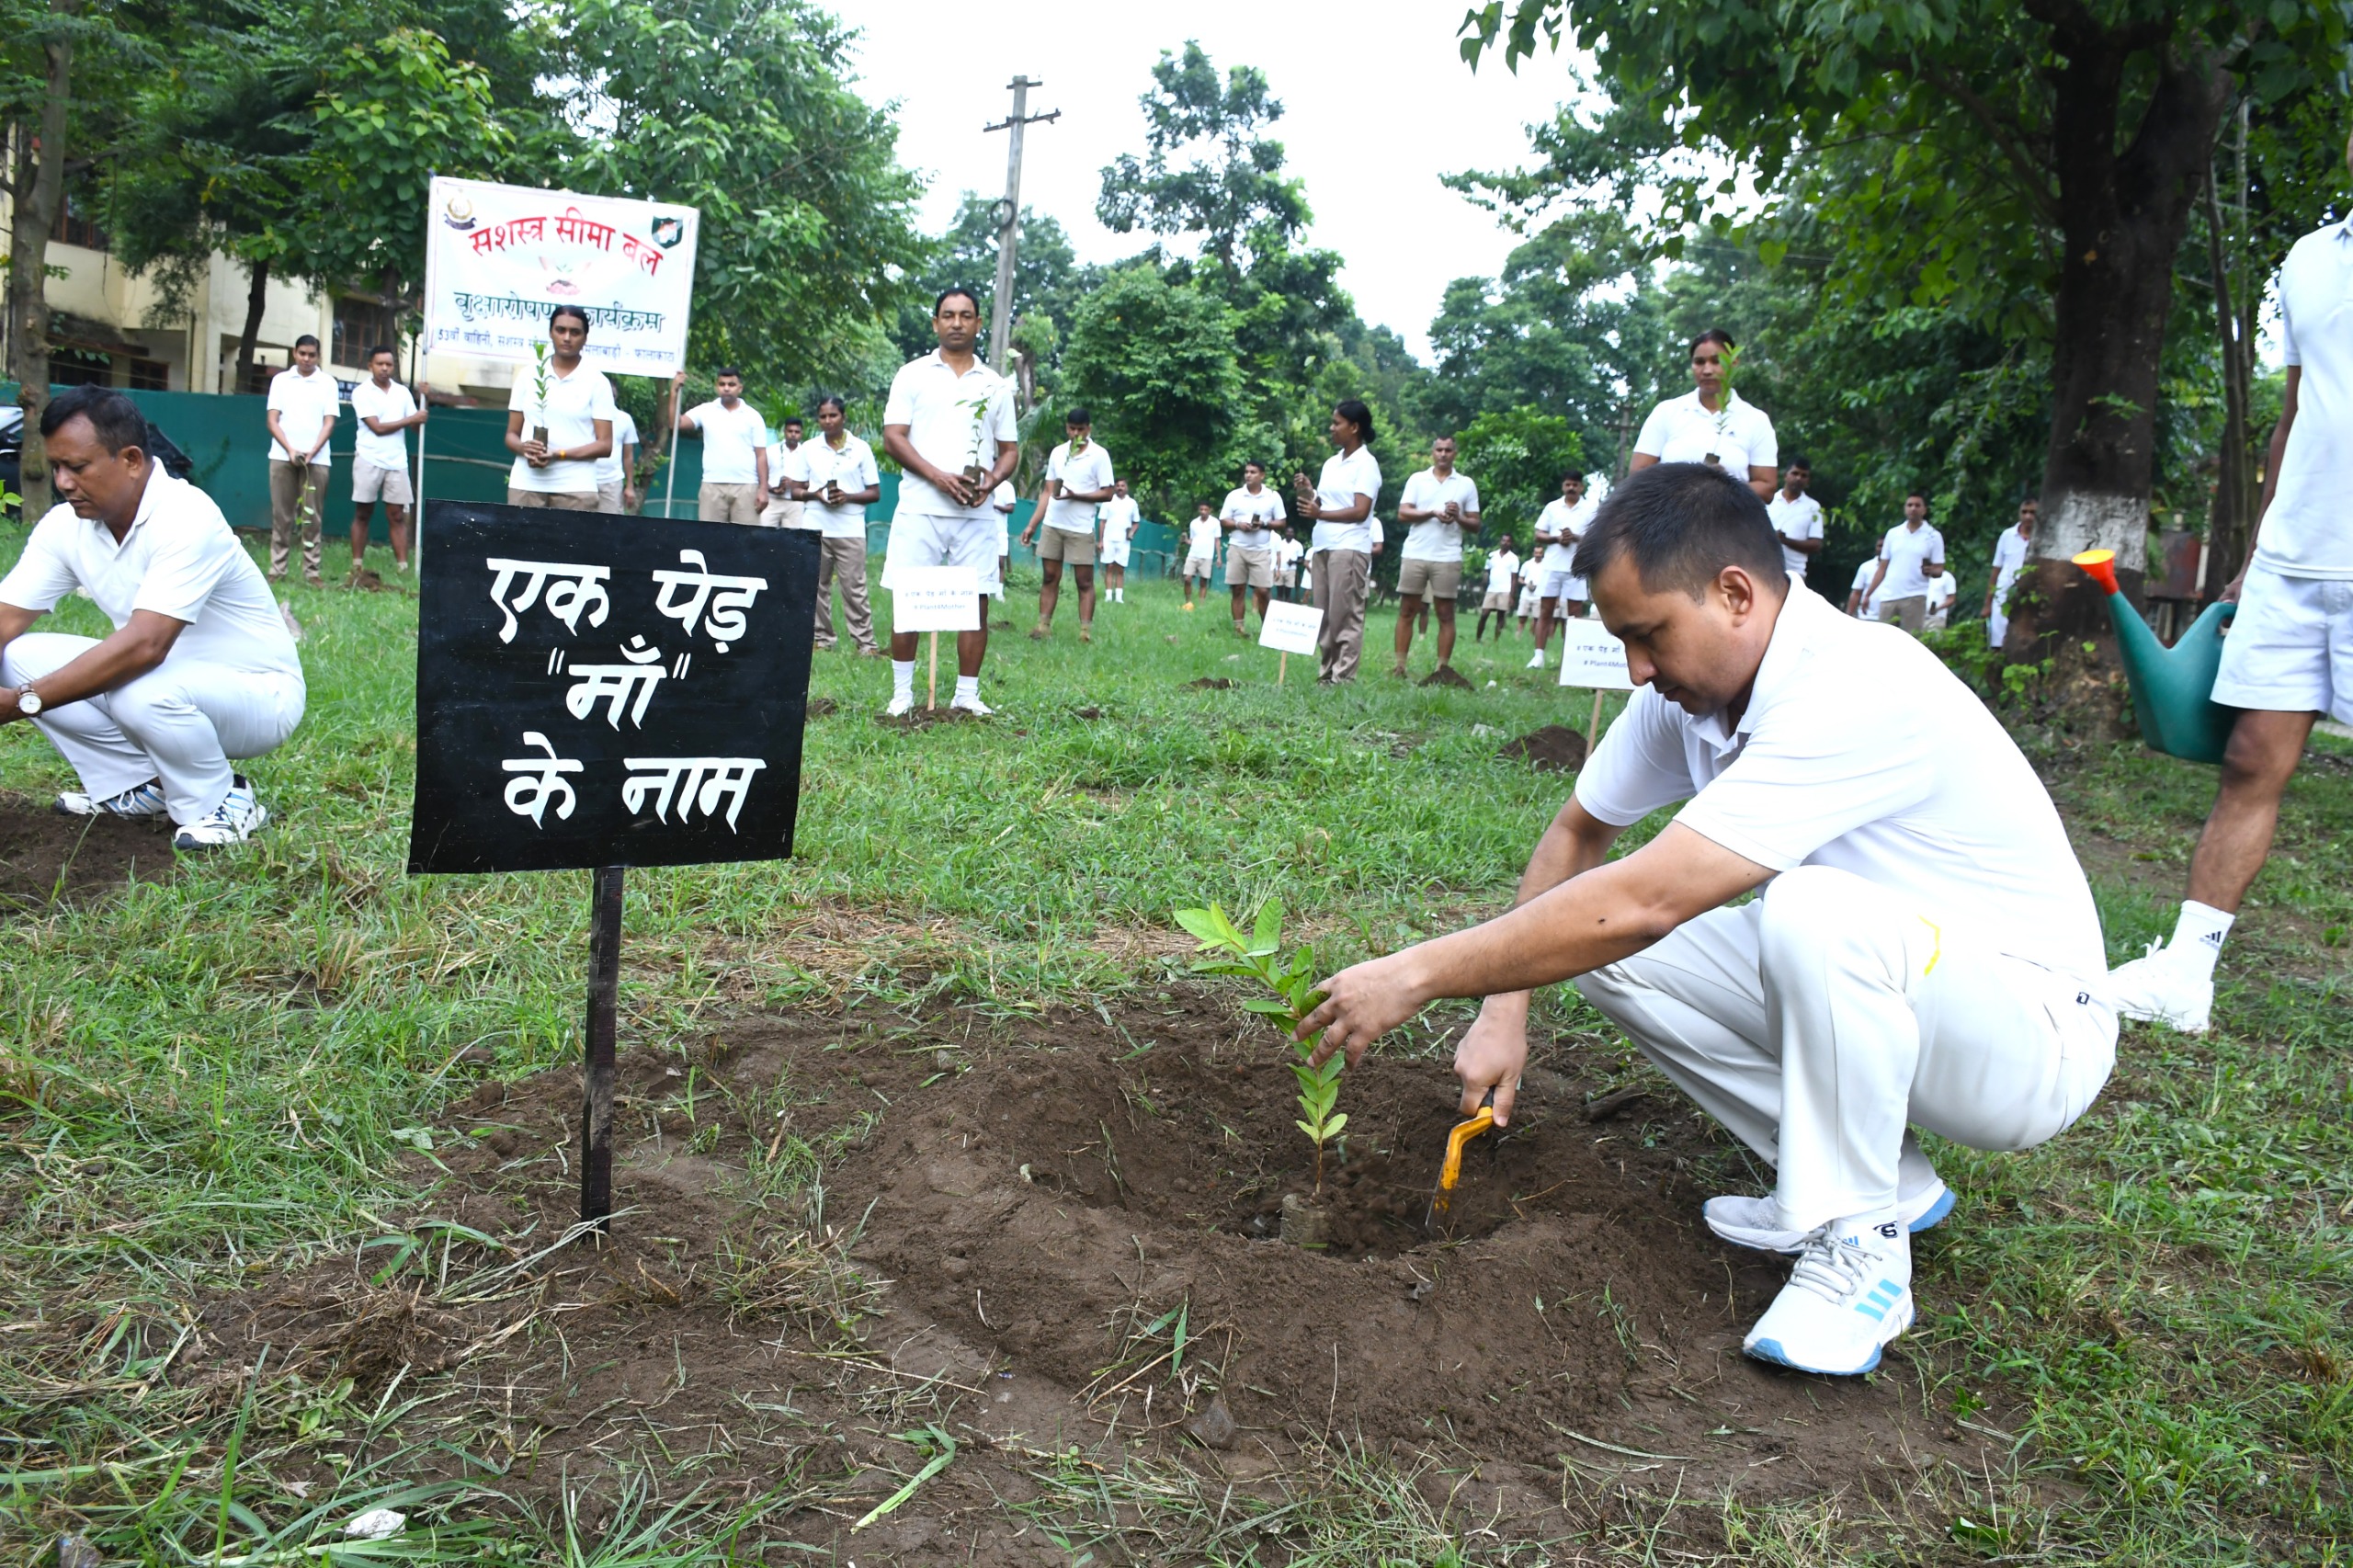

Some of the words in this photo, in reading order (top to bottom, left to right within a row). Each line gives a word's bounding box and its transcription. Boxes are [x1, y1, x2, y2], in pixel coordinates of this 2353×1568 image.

[468, 216, 548, 256] सशस्त्र
[554, 206, 617, 252] सीमा
[622, 233, 664, 277] बल
[486, 557, 611, 644] एक
[653, 549, 768, 653] पेड़
[501, 732, 585, 830] के
[621, 756, 767, 835] नाम
